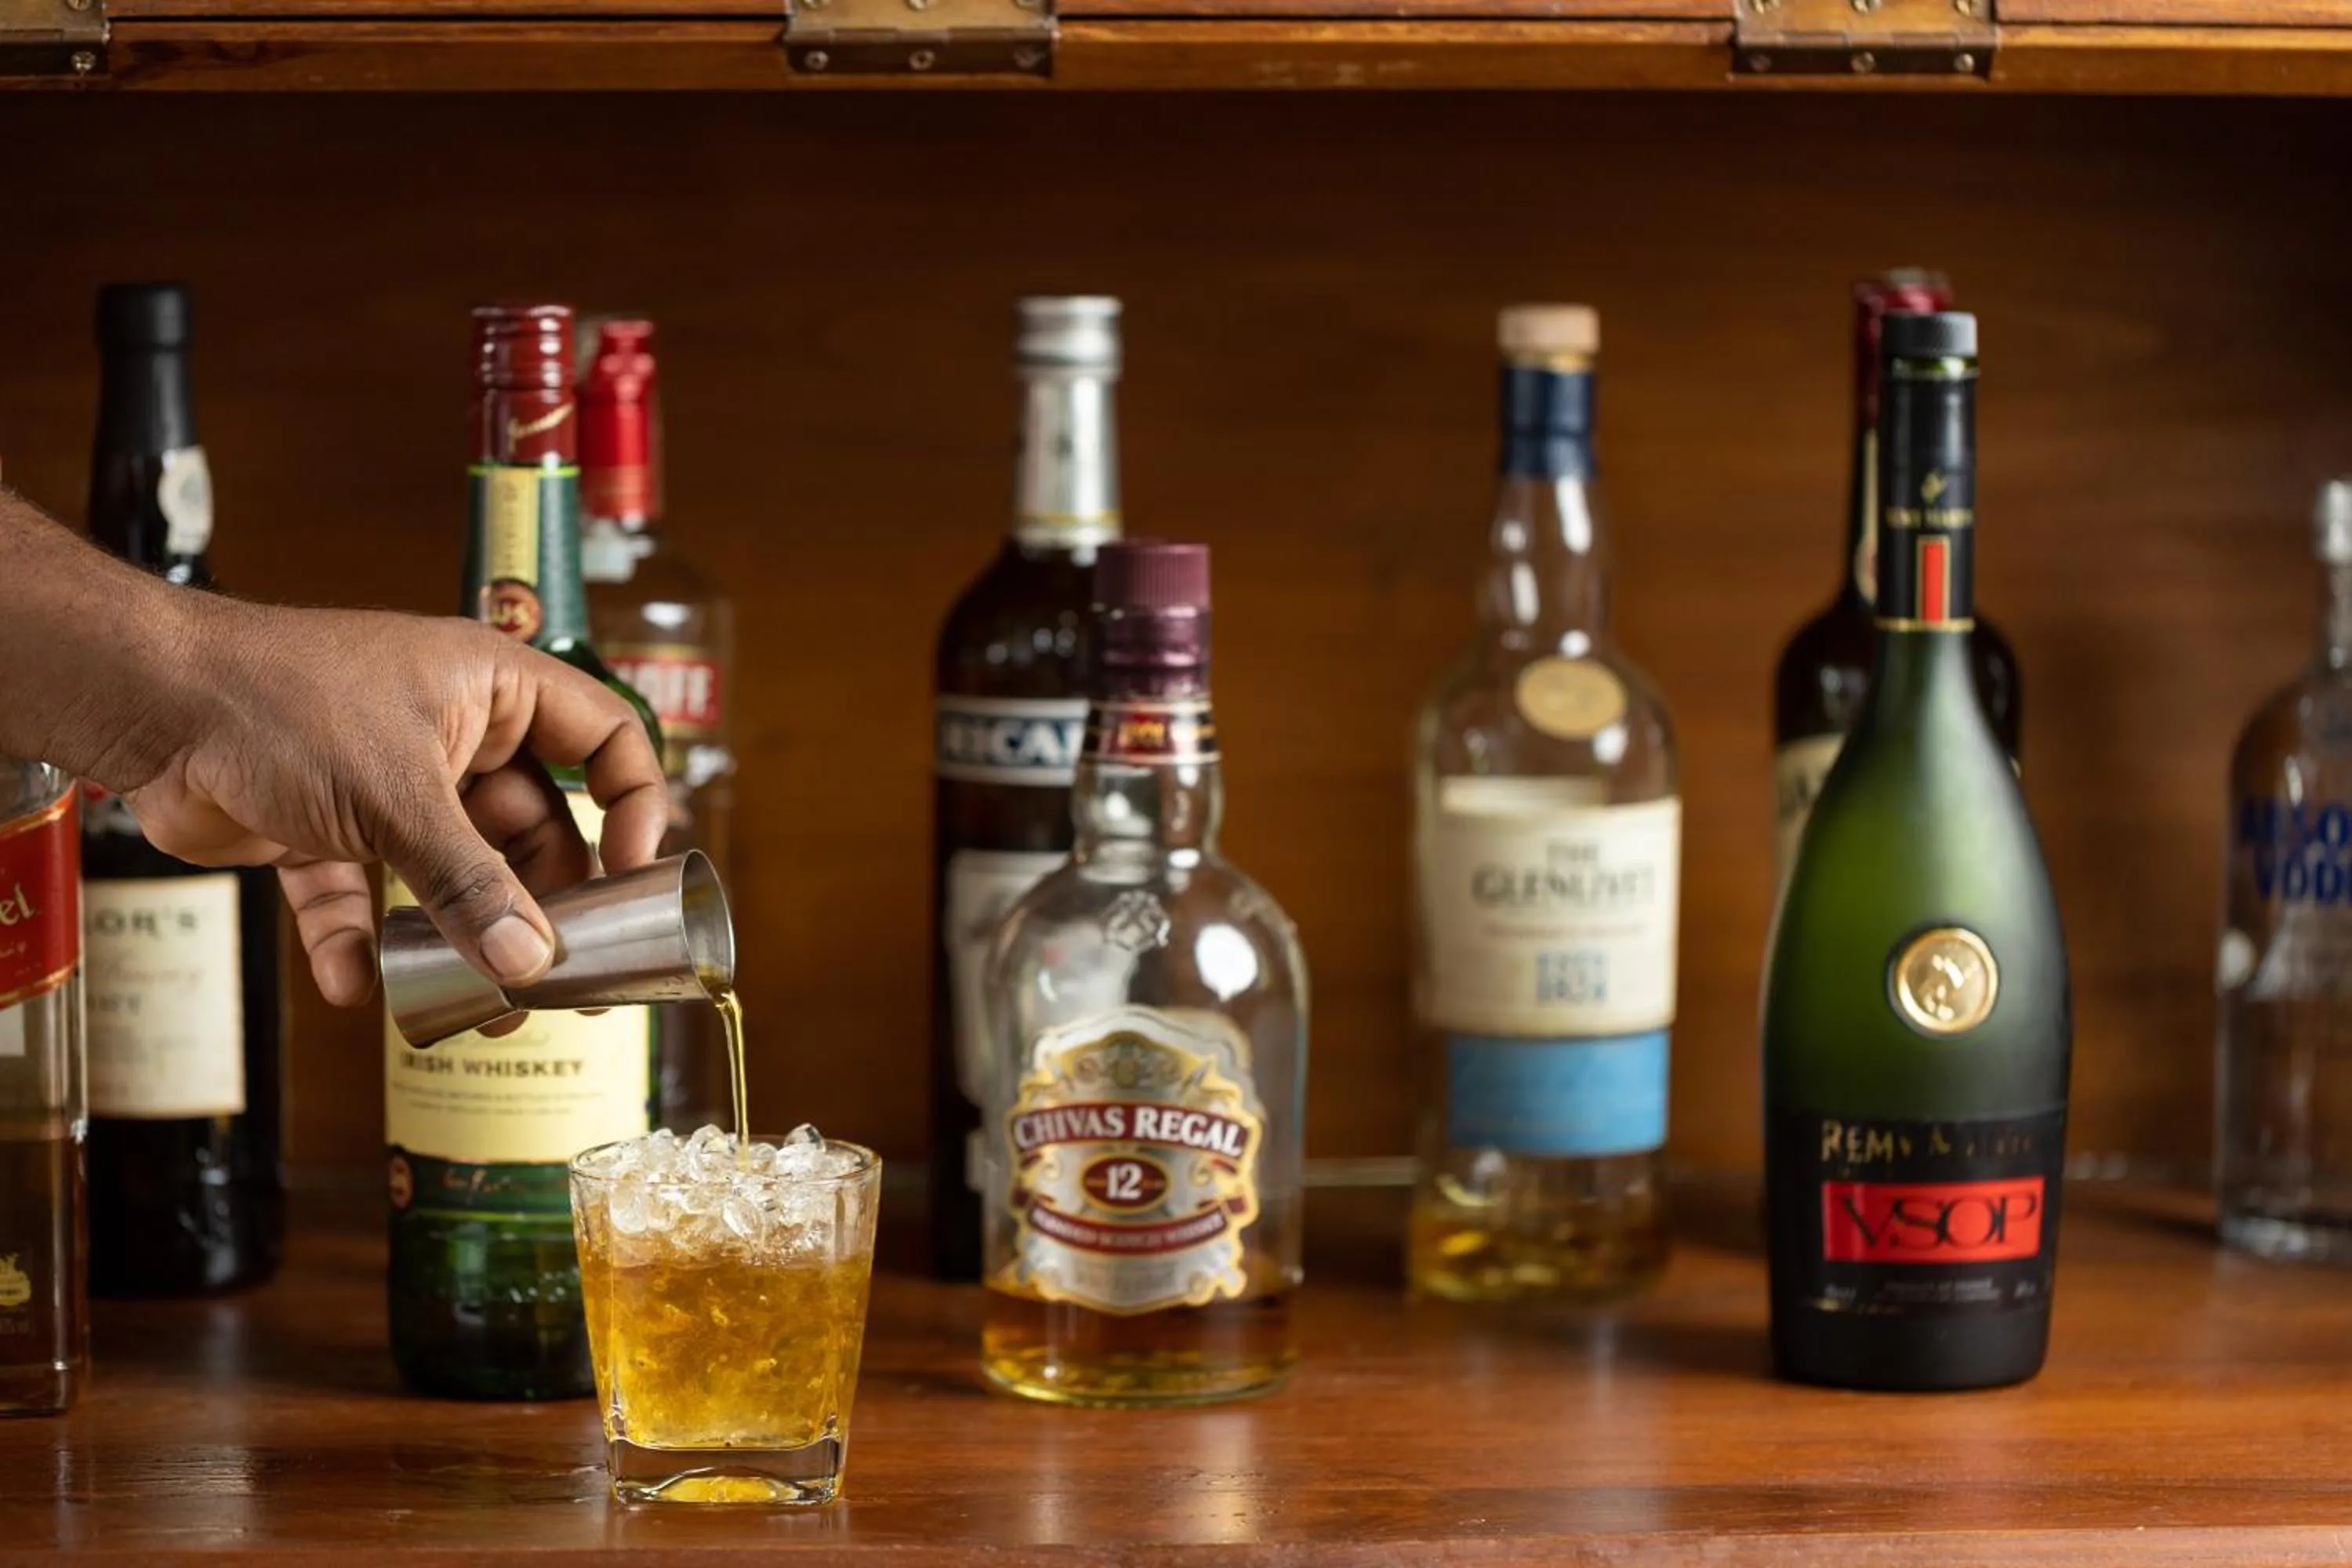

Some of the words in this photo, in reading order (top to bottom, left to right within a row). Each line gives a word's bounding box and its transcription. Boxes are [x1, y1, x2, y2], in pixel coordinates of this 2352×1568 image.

[399, 1051, 454, 1075] IRISH
[463, 1058, 585, 1078] WHISKEY
[1014, 1105, 1126, 1149] CHIVAS
[1134, 1106, 1243, 1156] REGAL
[1106, 1163, 1143, 1200] 12
[1841, 1190, 2038, 1250] VSOP
